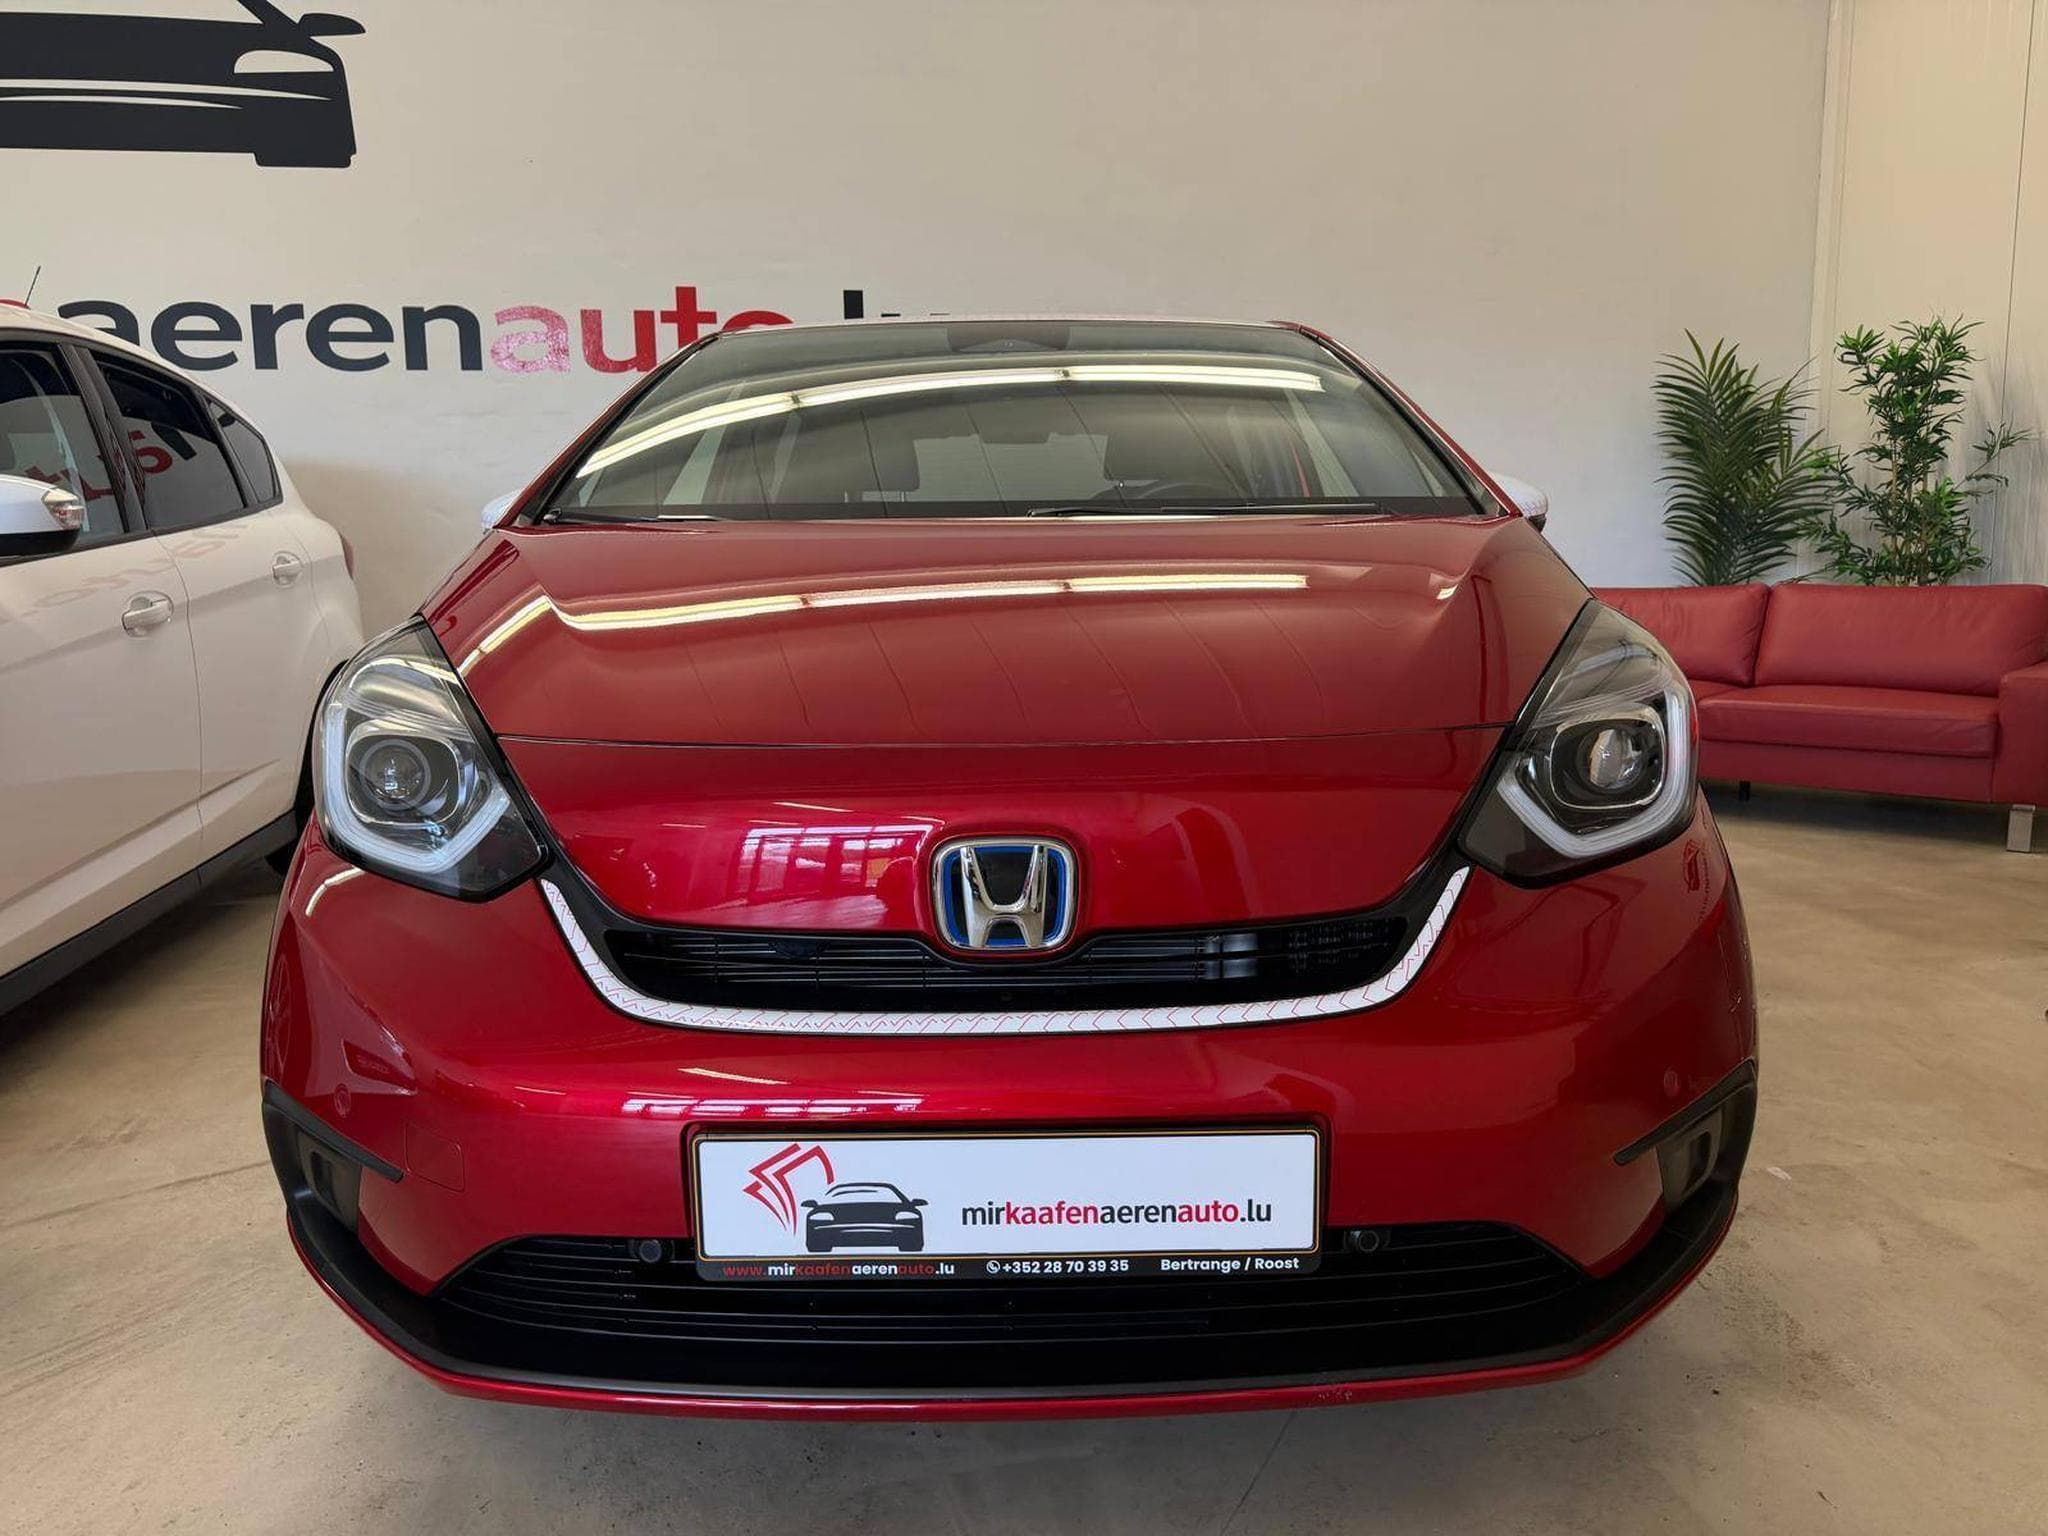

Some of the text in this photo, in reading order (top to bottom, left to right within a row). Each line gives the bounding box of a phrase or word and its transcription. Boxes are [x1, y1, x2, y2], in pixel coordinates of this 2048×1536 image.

[962, 1199, 1271, 1225] mirkaafenaerenauto.lu
[723, 1261, 955, 1277] www.mirkaafenaerenauto.lu
[1002, 1259, 1129, 1274] +352 28 70 39 35
[1160, 1257, 1300, 1274] Bertrange / Roost
